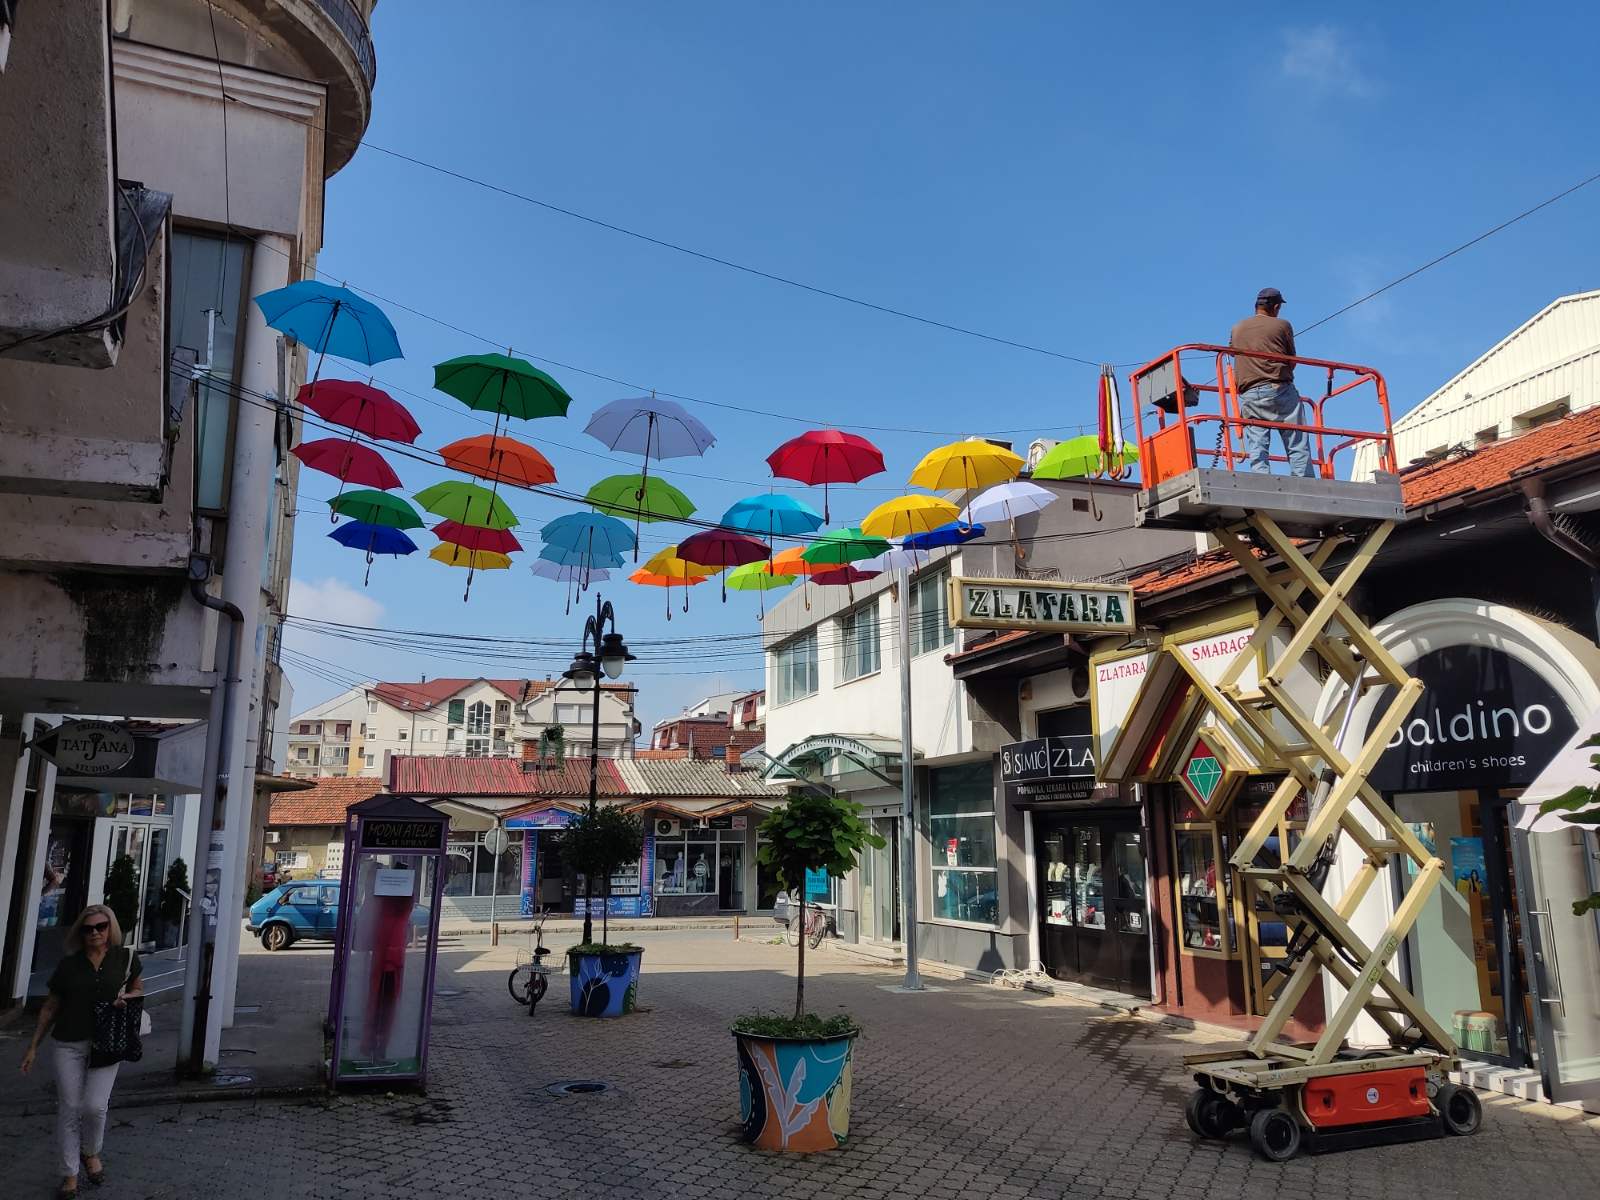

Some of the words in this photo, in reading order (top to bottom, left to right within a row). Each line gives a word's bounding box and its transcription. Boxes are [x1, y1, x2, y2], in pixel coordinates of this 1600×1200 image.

[968, 588, 1125, 623] ZLATARA
[1099, 661, 1147, 682] ZLATARA
[60, 733, 130, 760] TATJANA
[1410, 757, 1477, 773] children's
[1482, 755, 1526, 768] shoes
